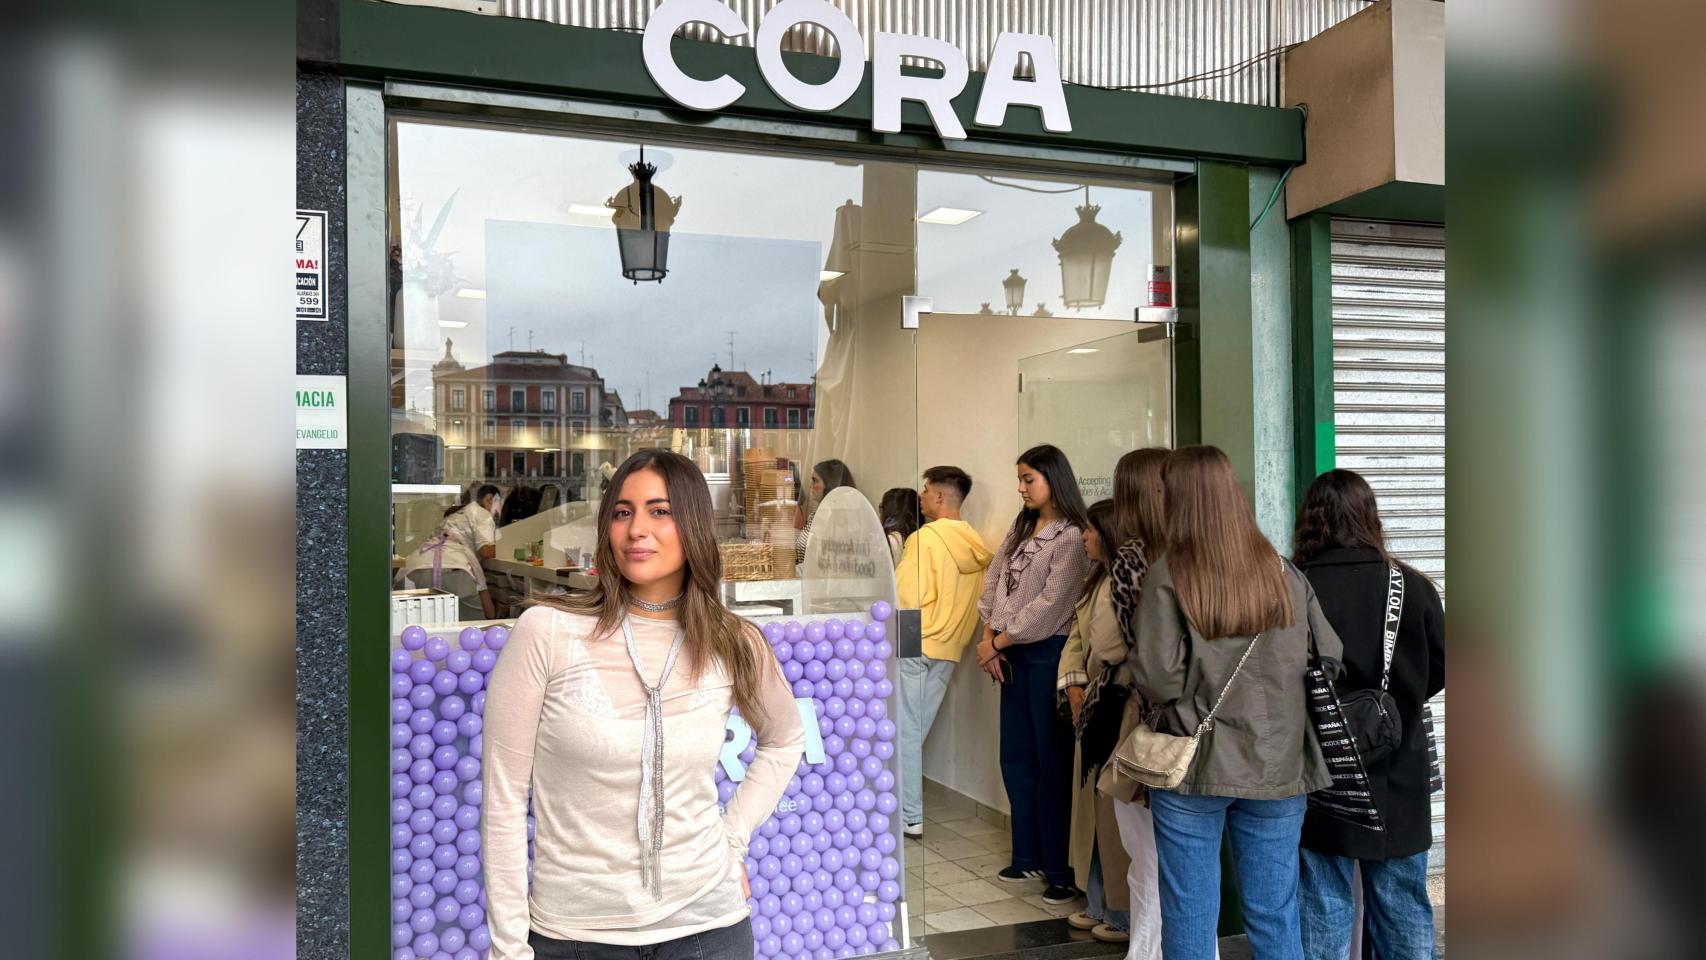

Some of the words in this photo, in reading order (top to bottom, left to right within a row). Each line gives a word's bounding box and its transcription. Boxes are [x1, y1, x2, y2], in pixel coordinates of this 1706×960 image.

[642, 0, 1073, 139] CORA
[300, 297, 319, 305] 599
[296, 429, 338, 439] EVANGELIO
